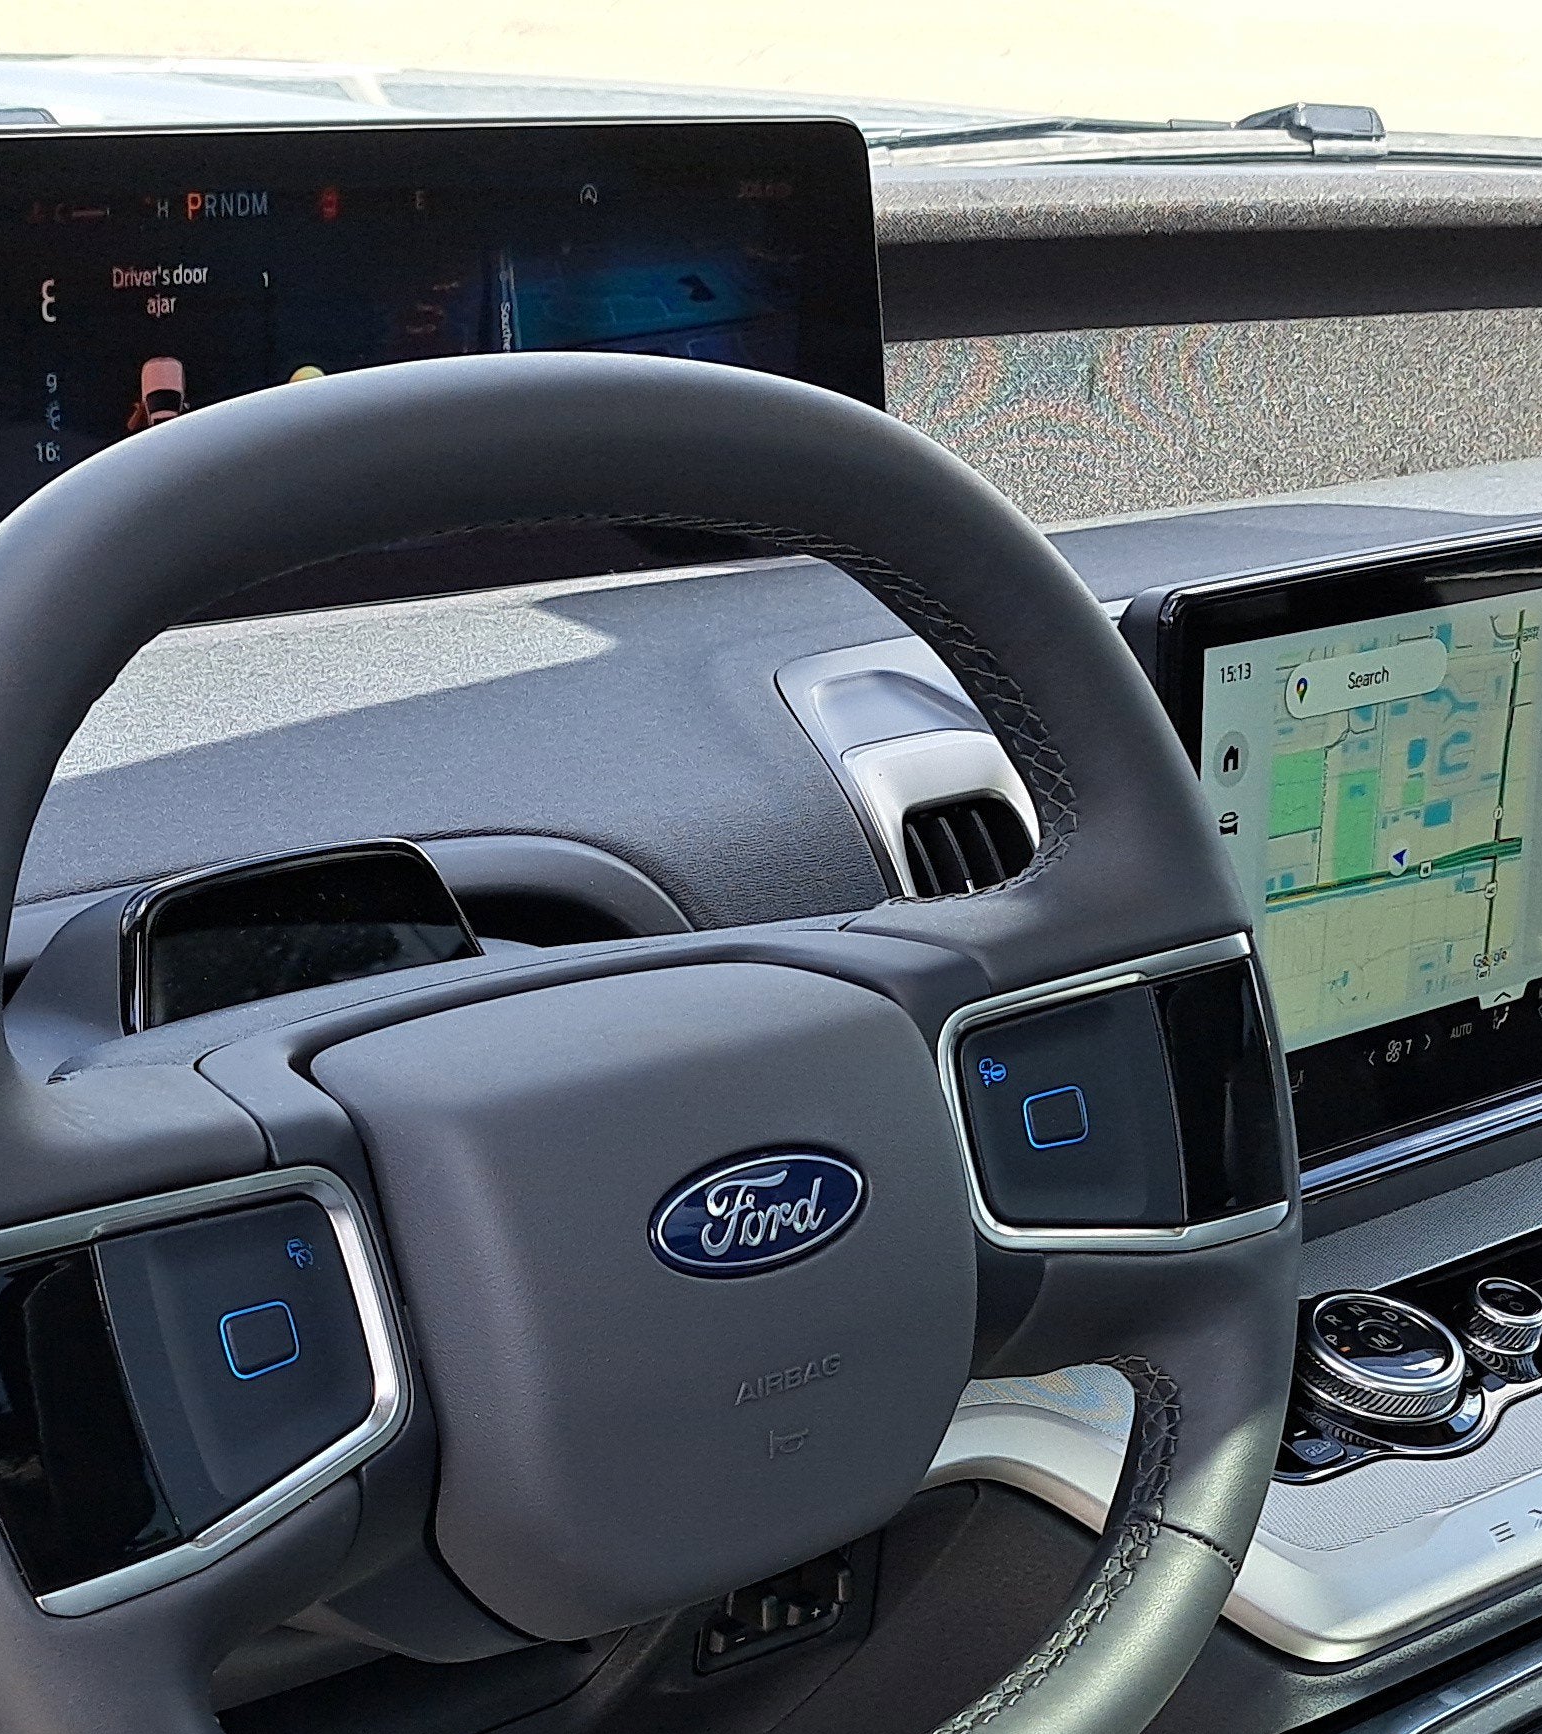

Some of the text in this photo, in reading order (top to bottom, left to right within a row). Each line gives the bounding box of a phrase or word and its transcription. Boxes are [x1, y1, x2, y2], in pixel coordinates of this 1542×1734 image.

[111, 263, 209, 290] Driver's door
[146, 294, 177, 319] ajar
[1219, 662, 1252, 684] 15:13
[1348, 666, 1390, 690] Search
[1449, 1023, 1473, 1040] AUTO
[701, 1169, 827, 1257] Ford
[1370, 1333, 1395, 1348] M
[734, 1352, 842, 1407] AIRBAG
